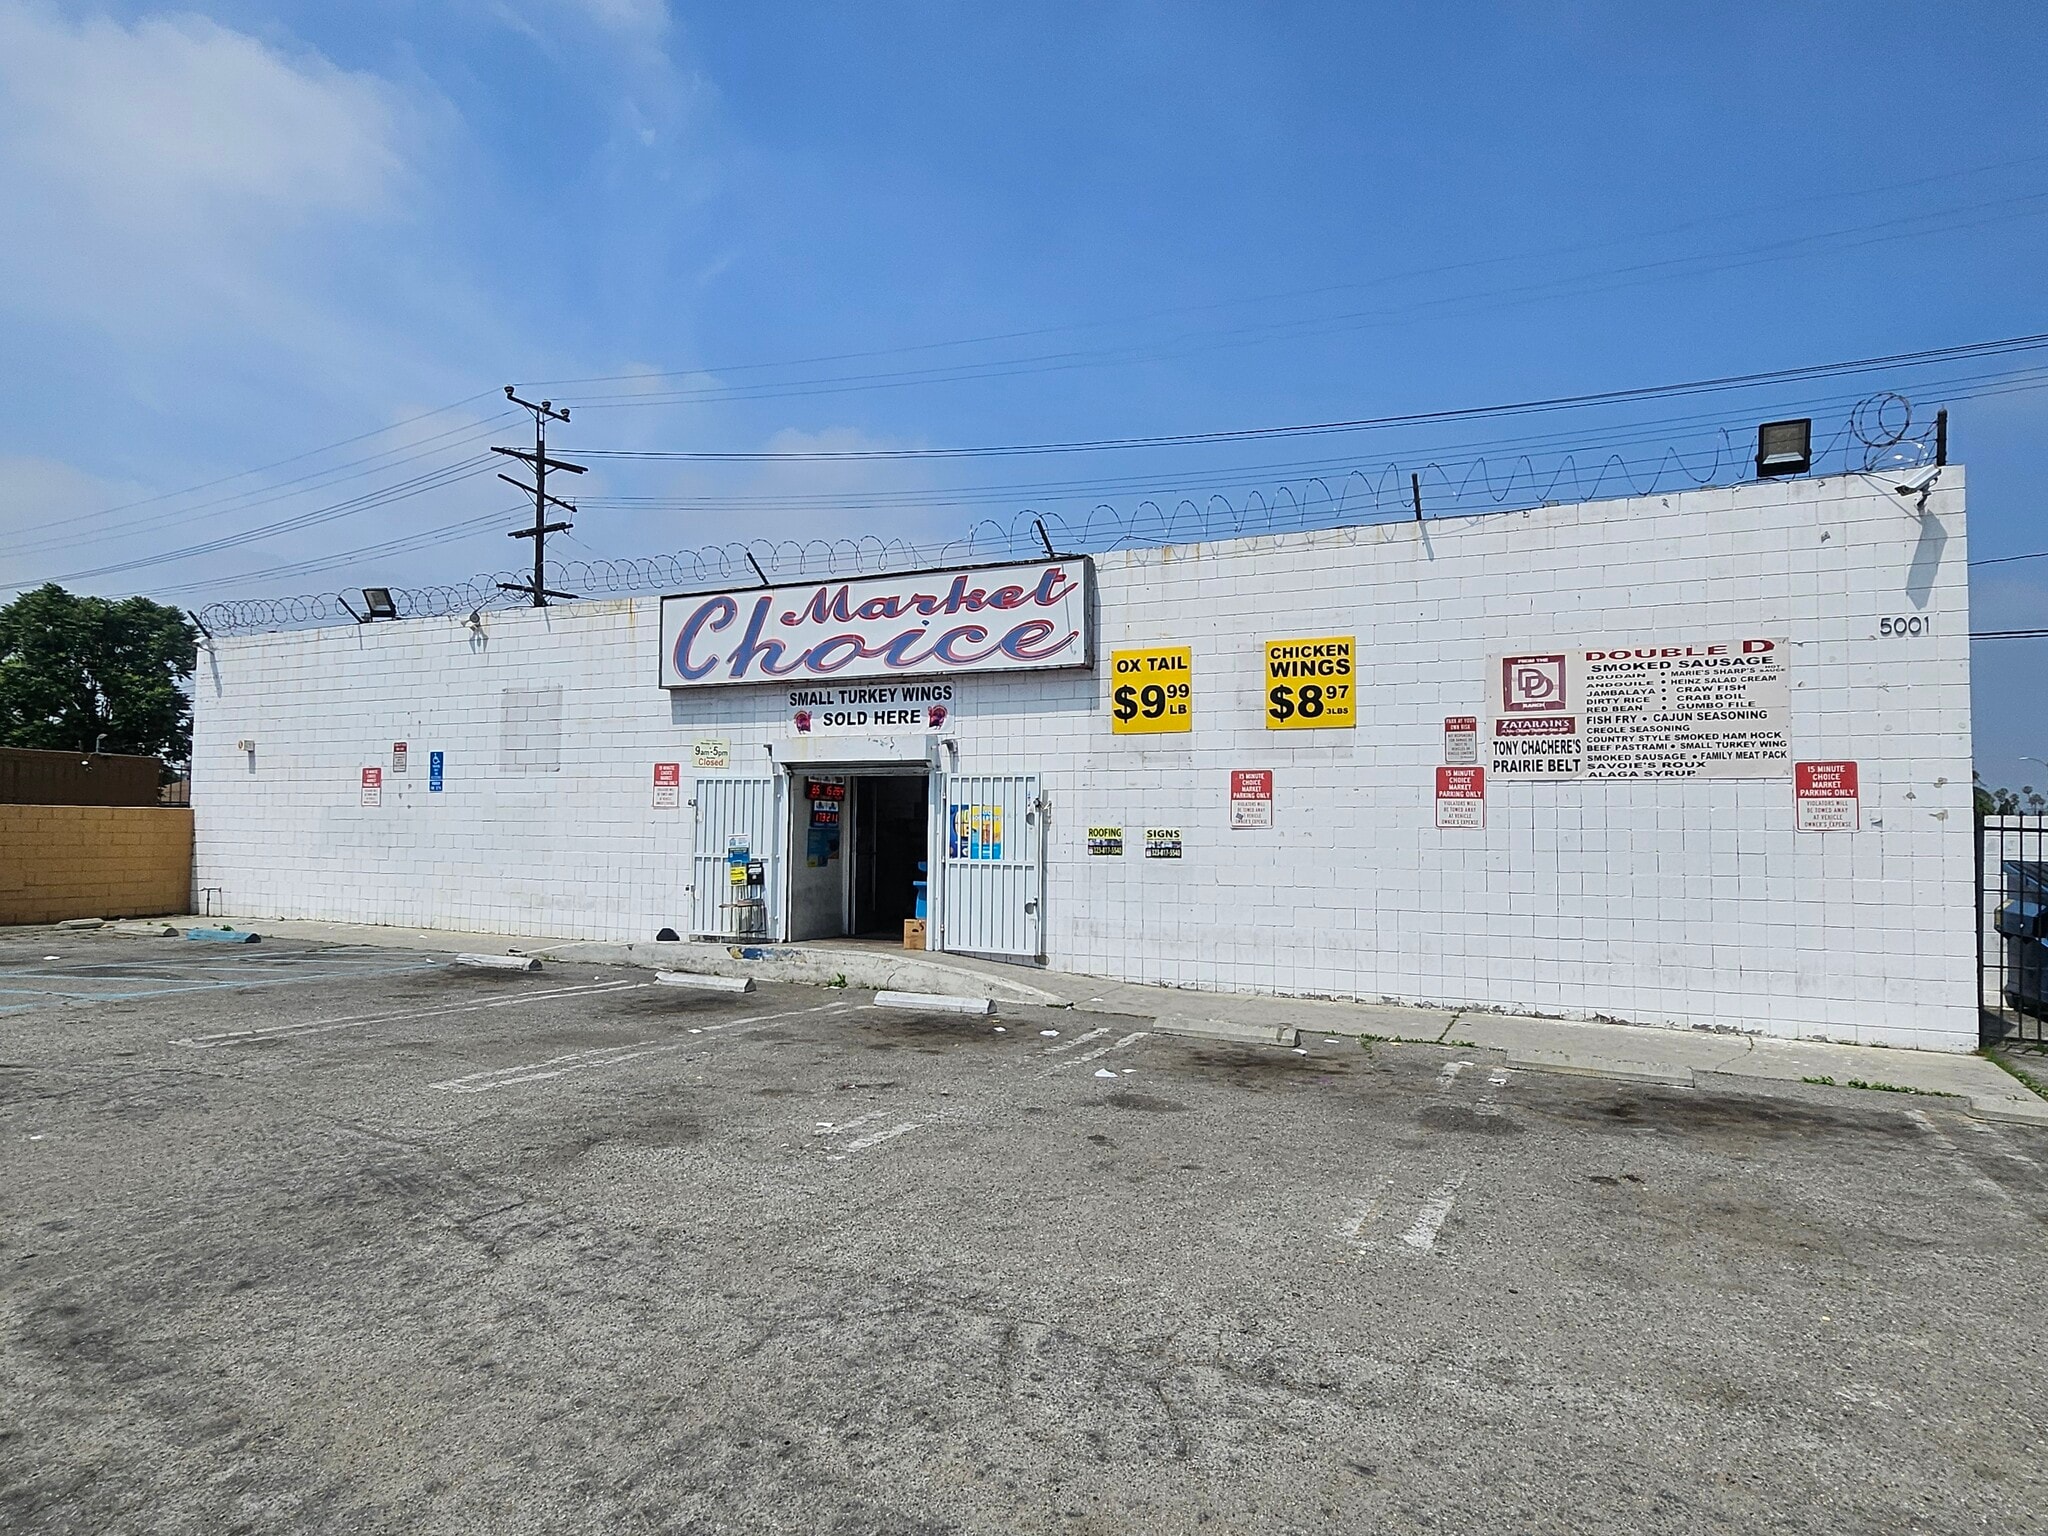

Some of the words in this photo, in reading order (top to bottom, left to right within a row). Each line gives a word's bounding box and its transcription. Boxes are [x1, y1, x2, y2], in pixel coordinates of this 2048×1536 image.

[781, 566, 1079, 626] Market
[1880, 616, 1929, 634] 5001
[674, 595, 1079, 680] Choice
[1270, 643, 1349, 659] CHICKEN
[1586, 645, 1728, 661] DOUBLE
[1743, 640, 1775, 653] D
[1116, 659, 1141, 673] OX
[1146, 656, 1187, 671] TAIL
[1269, 658, 1351, 677] WINGS
[1591, 661, 1671, 672] SMOKED
[1679, 656, 1774, 668] SAUSAGE
[789, 688, 834, 706] SMALL
[839, 686, 896, 704] TURKEY
[901, 684, 952, 702] WINGS
[1170, 704, 1187, 714] LB
[1326, 707, 1348, 715] 3LBS
[1587, 716, 1611, 724] FISH
[1616, 715, 1637, 723] FRY
[1653, 713, 1692, 722] CAJUN
[1697, 710, 1767, 720] SEASONING
[822, 710, 868, 726] SOLD
[874, 709, 921, 725] HERE
[1502, 720, 1569, 728] ZATARAIN'S
[1722, 732, 1746, 740] HAM
[1493, 740, 1518, 755] TONY
[1521, 739, 1581, 755] CHACHERE'S
[1616, 743, 1667, 751] PASTRAMI
[1701, 752, 1733, 760] FAMILY
[1736, 751, 1760, 759] MEAT
[1763, 751, 1787, 759] PACK
[1493, 759, 1543, 773] PRAIRIE
[1548, 759, 1580, 772] BELT
[1089, 828, 1121, 837] ROOFING
